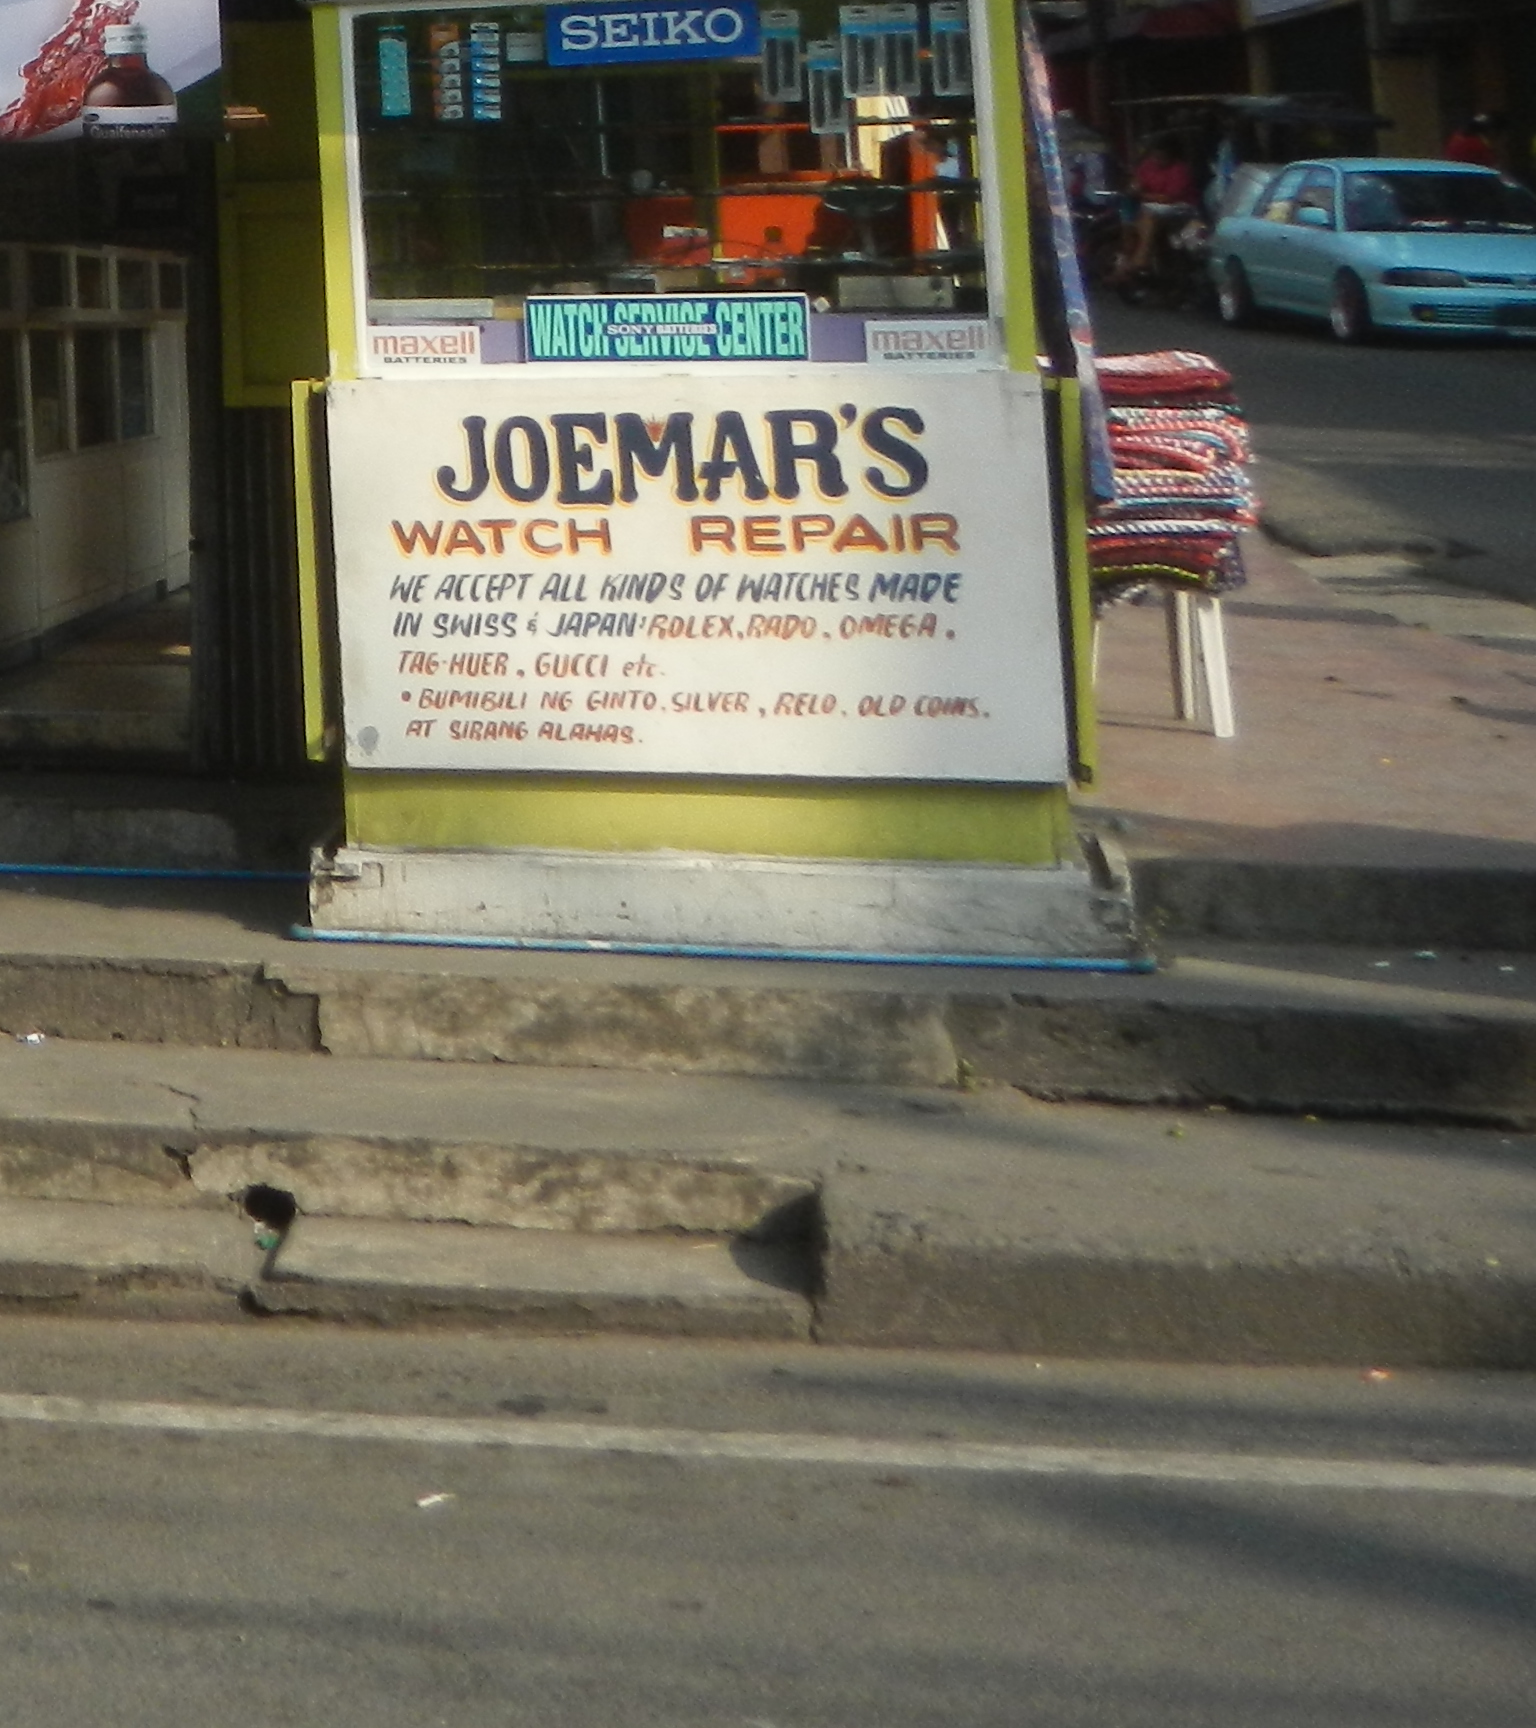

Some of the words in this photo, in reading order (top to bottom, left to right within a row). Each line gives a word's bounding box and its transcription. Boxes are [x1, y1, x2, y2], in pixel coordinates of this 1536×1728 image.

[559, 5, 745, 52] SEIKO
[372, 330, 475, 355] maxell
[529, 302, 611, 358] WATCH
[613, 301, 712, 358] SERVICE
[714, 300, 806, 357] CENTER
[605, 323, 655, 336] SONY
[871, 325, 986, 350] maxell
[383, 356, 468, 364] BATTERIES
[435, 402, 931, 508] JOEMAR'S
[390, 516, 615, 559] WATCH
[688, 511, 962, 558] REPAIR
[389, 573, 431, 603] WE
[434, 572, 534, 603] ACCEPT
[538, 572, 588, 603] ALL
[599, 571, 687, 604] KINDS
[694, 572, 730, 603] OF
[735, 571, 861, 604] WATCHES
[867, 571, 963, 604] MADE
[392, 611, 423, 638] IN
[431, 612, 519, 639] SWISS
[533, 651, 610, 679] GUCCI
[418, 687, 529, 712] BUMIBILI
[540, 689, 574, 712] NG
[856, 694, 908, 718] OLD
[404, 718, 439, 739] AT
[448, 719, 530, 742] SIRANG
